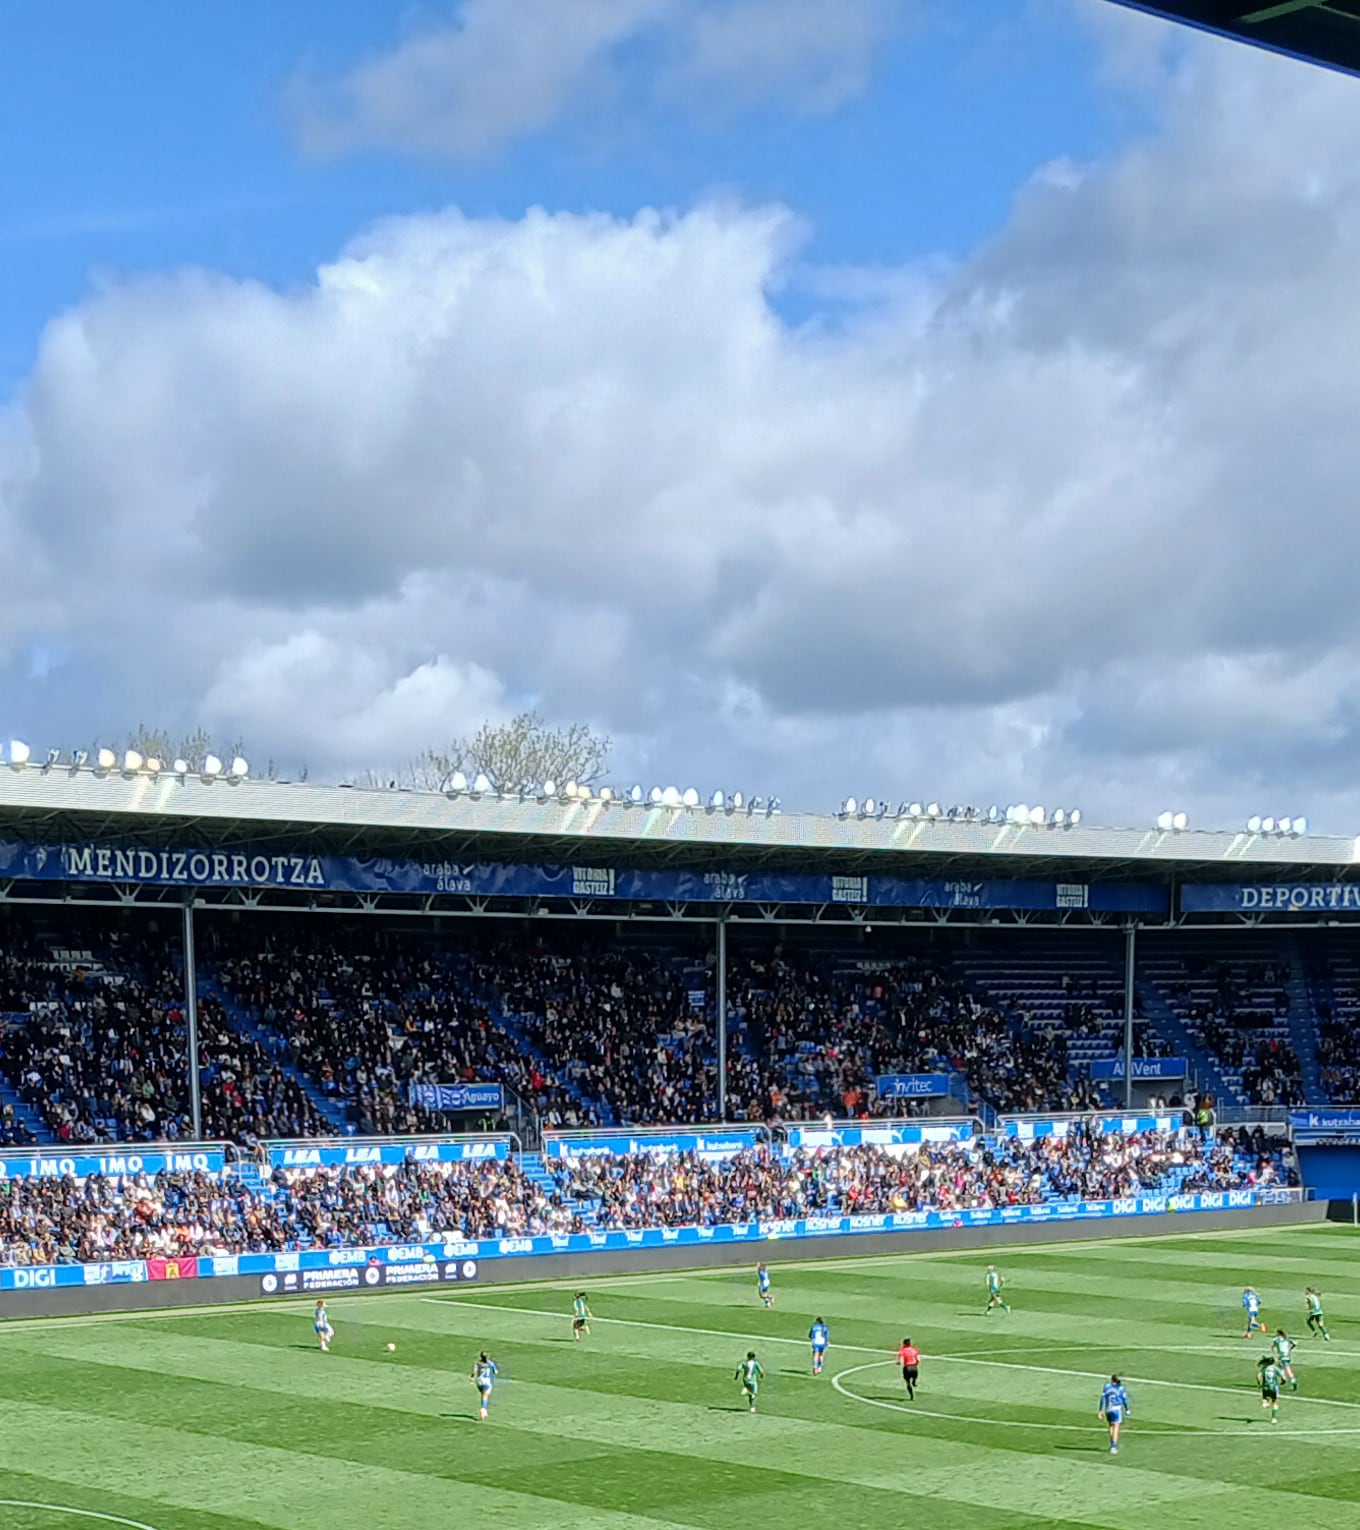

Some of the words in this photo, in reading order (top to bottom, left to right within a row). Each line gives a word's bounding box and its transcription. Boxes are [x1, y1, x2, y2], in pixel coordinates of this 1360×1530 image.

[68, 847, 325, 885] MENDIZORROTZA
[423, 862, 459, 876] araba
[166, 1153, 210, 1171] IMQ
[284, 1150, 321, 1165] LEA
[345, 1147, 381, 1163] LEA
[30, 1157, 76, 1177] IMQ
[1172, 1197, 1195, 1210] DIGI
[1201, 1194, 1223, 1208] DIGI
[1229, 1192, 1252, 1206] DIGI
[1113, 1201, 1137, 1214] DIGI
[1143, 1199, 1165, 1214] DIGI
[303, 1268, 359, 1282] PRIMERA
[386, 1263, 438, 1276] PRIMERA
[14, 1268, 56, 1288] DIGI
